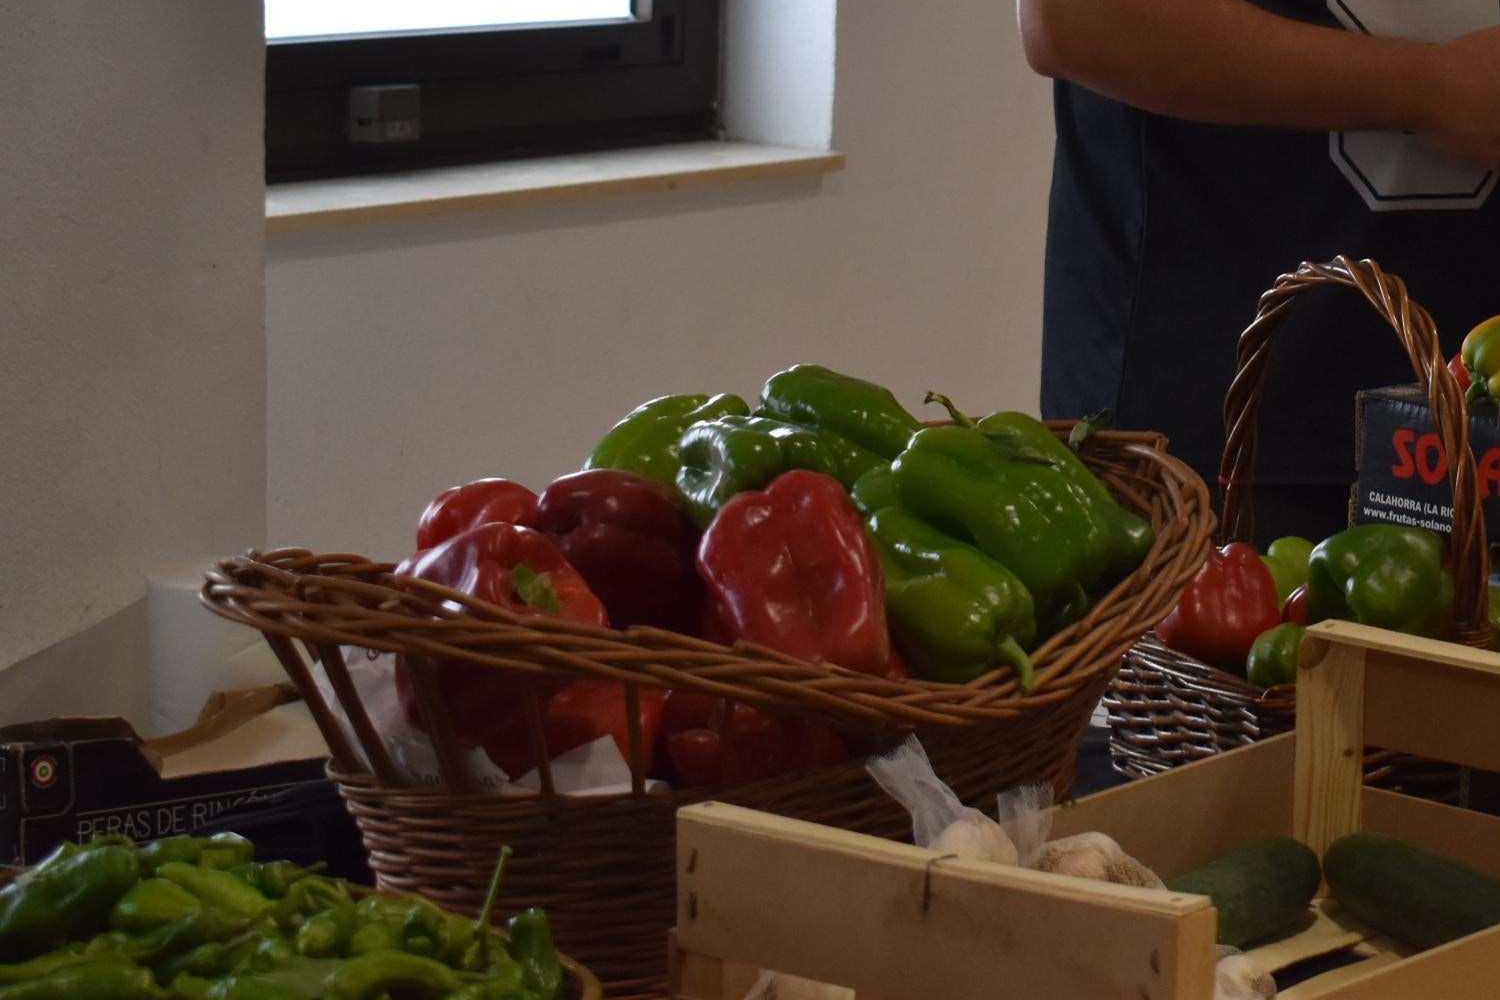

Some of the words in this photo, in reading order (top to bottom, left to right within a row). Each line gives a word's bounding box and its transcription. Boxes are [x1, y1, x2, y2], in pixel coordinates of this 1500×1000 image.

[1369, 491, 1421, 512] CALAHORRA
[1423, 502, 1438, 516] (LA
[1363, 506, 1452, 533] www.frutas-solano
[77, 811, 151, 845] PERAS
[157, 807, 185, 835] DE
